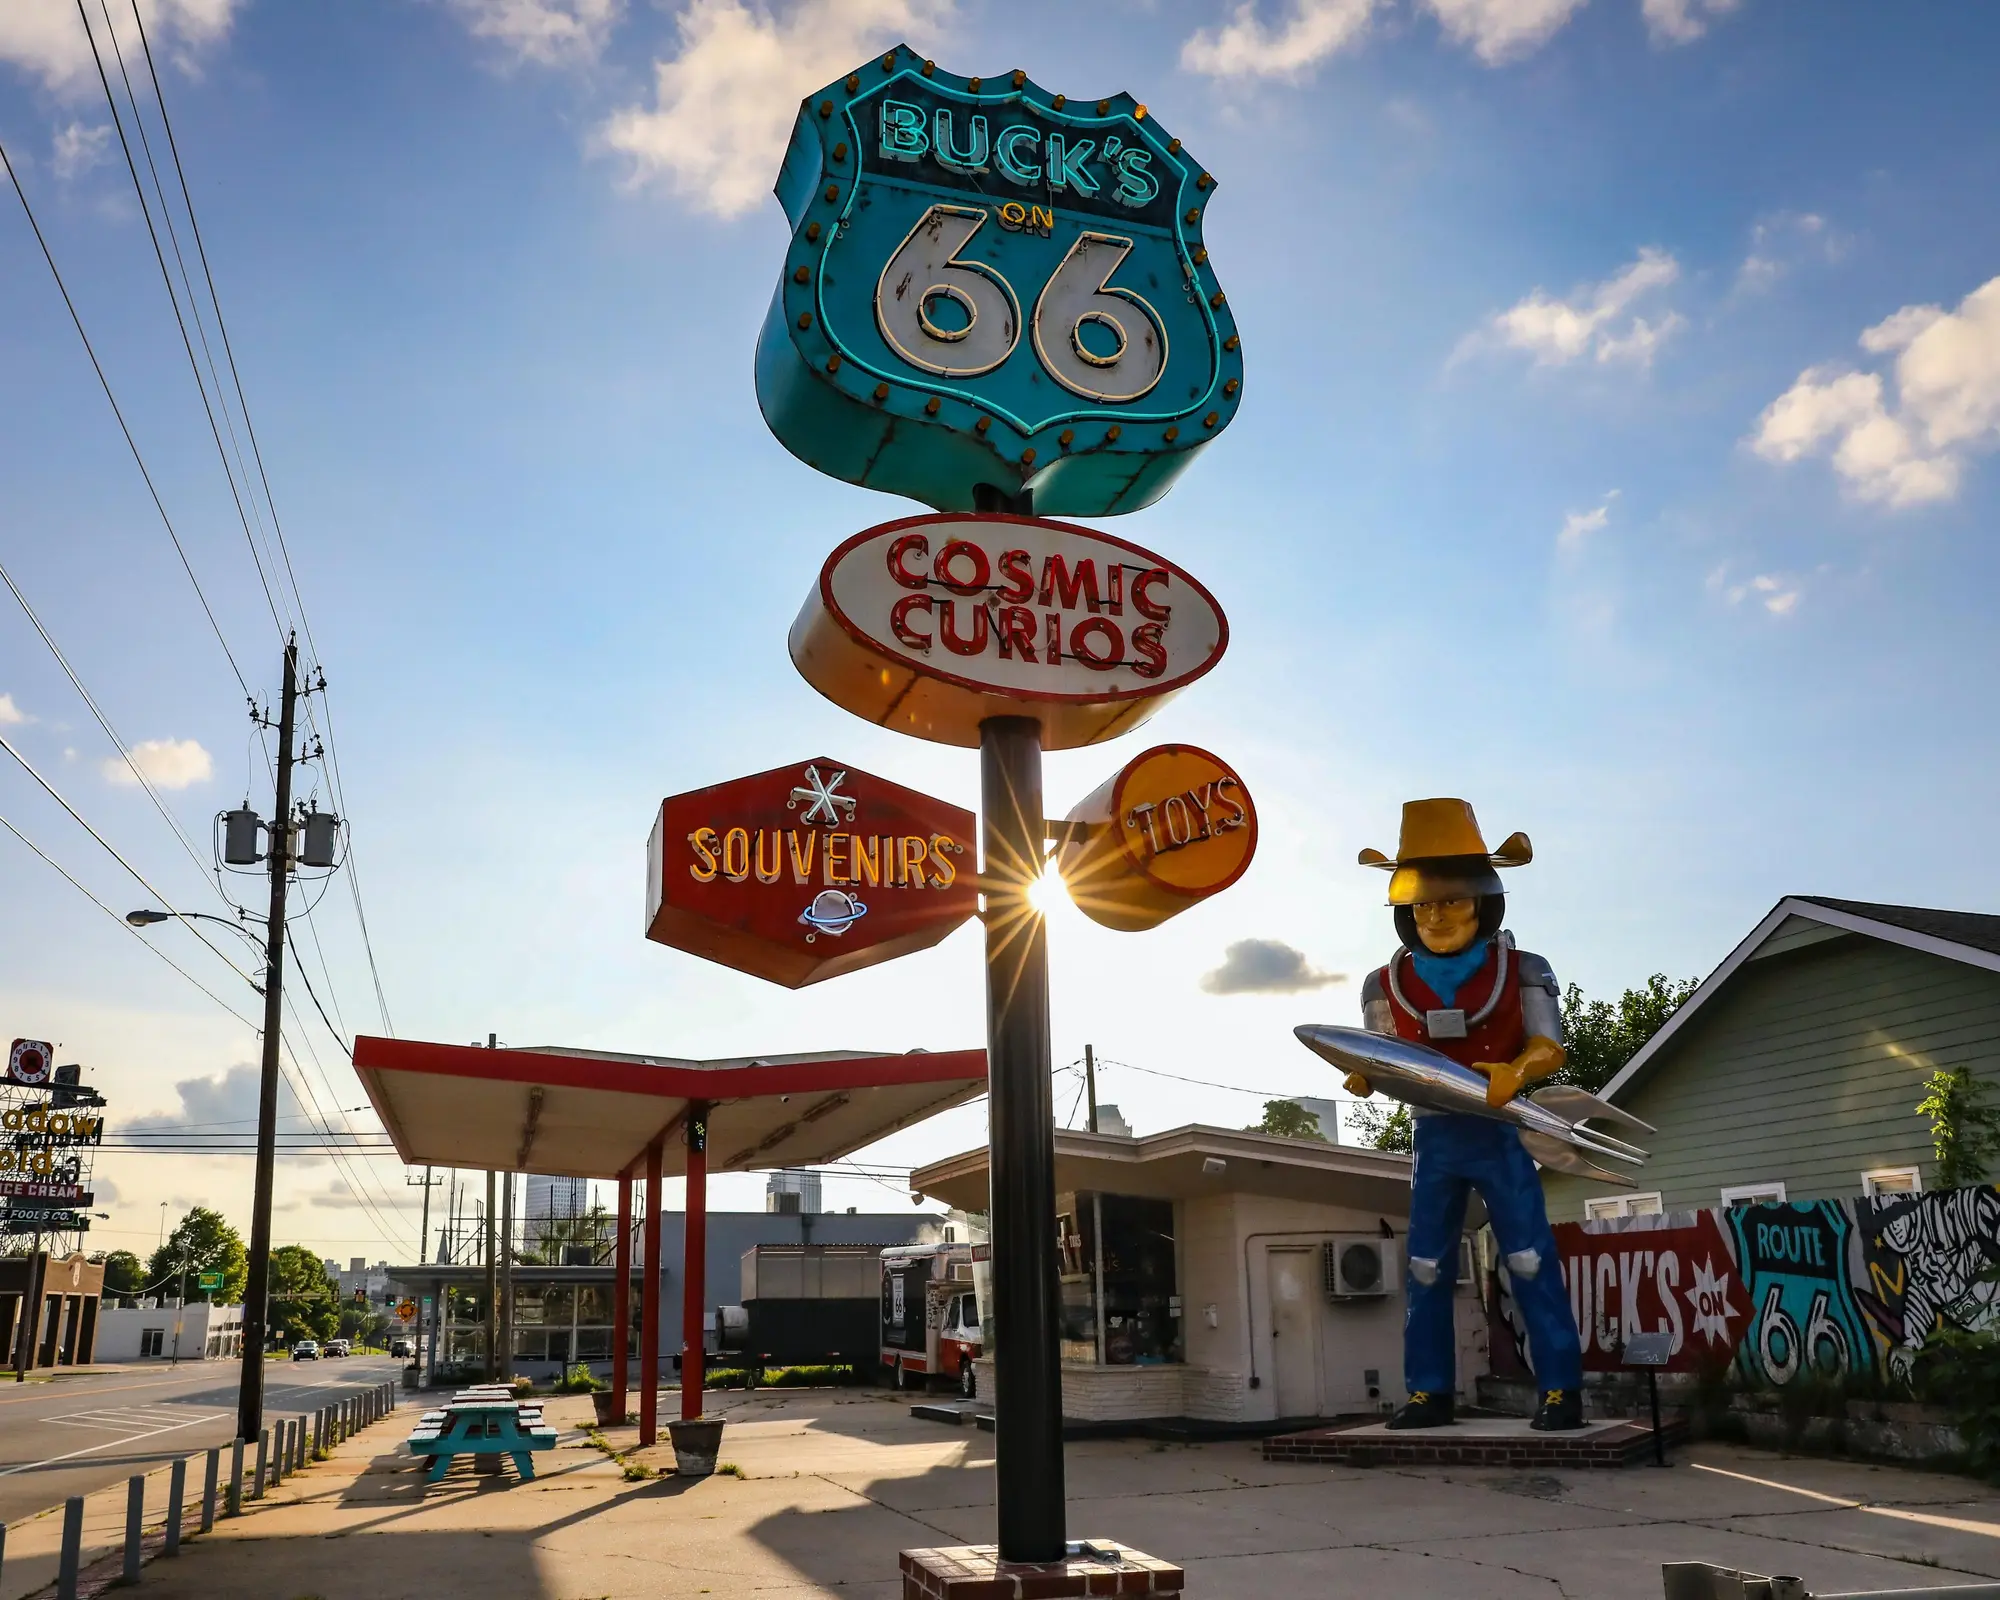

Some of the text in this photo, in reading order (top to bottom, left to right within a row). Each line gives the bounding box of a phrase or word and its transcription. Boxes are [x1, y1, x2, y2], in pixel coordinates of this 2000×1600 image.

[879, 99, 1159, 208] BUCK'S
[996, 202, 1054, 238] ON
[873, 204, 1169, 404] 66
[887, 534, 1170, 622] COSMIC
[890, 593, 1168, 679] CURIOS
[1128, 776, 1246, 855] TOYS
[689, 826, 960, 890] SOUVENIRS
[0, 1103, 97, 1136] adow
[27, 1184, 78, 1198] CREAM
[51, 1211, 70, 1221] CO.
[1756, 1222, 1826, 1267] ROUTE
[1698, 1289, 1724, 1317] ON
[1758, 1284, 1849, 1386] 66
